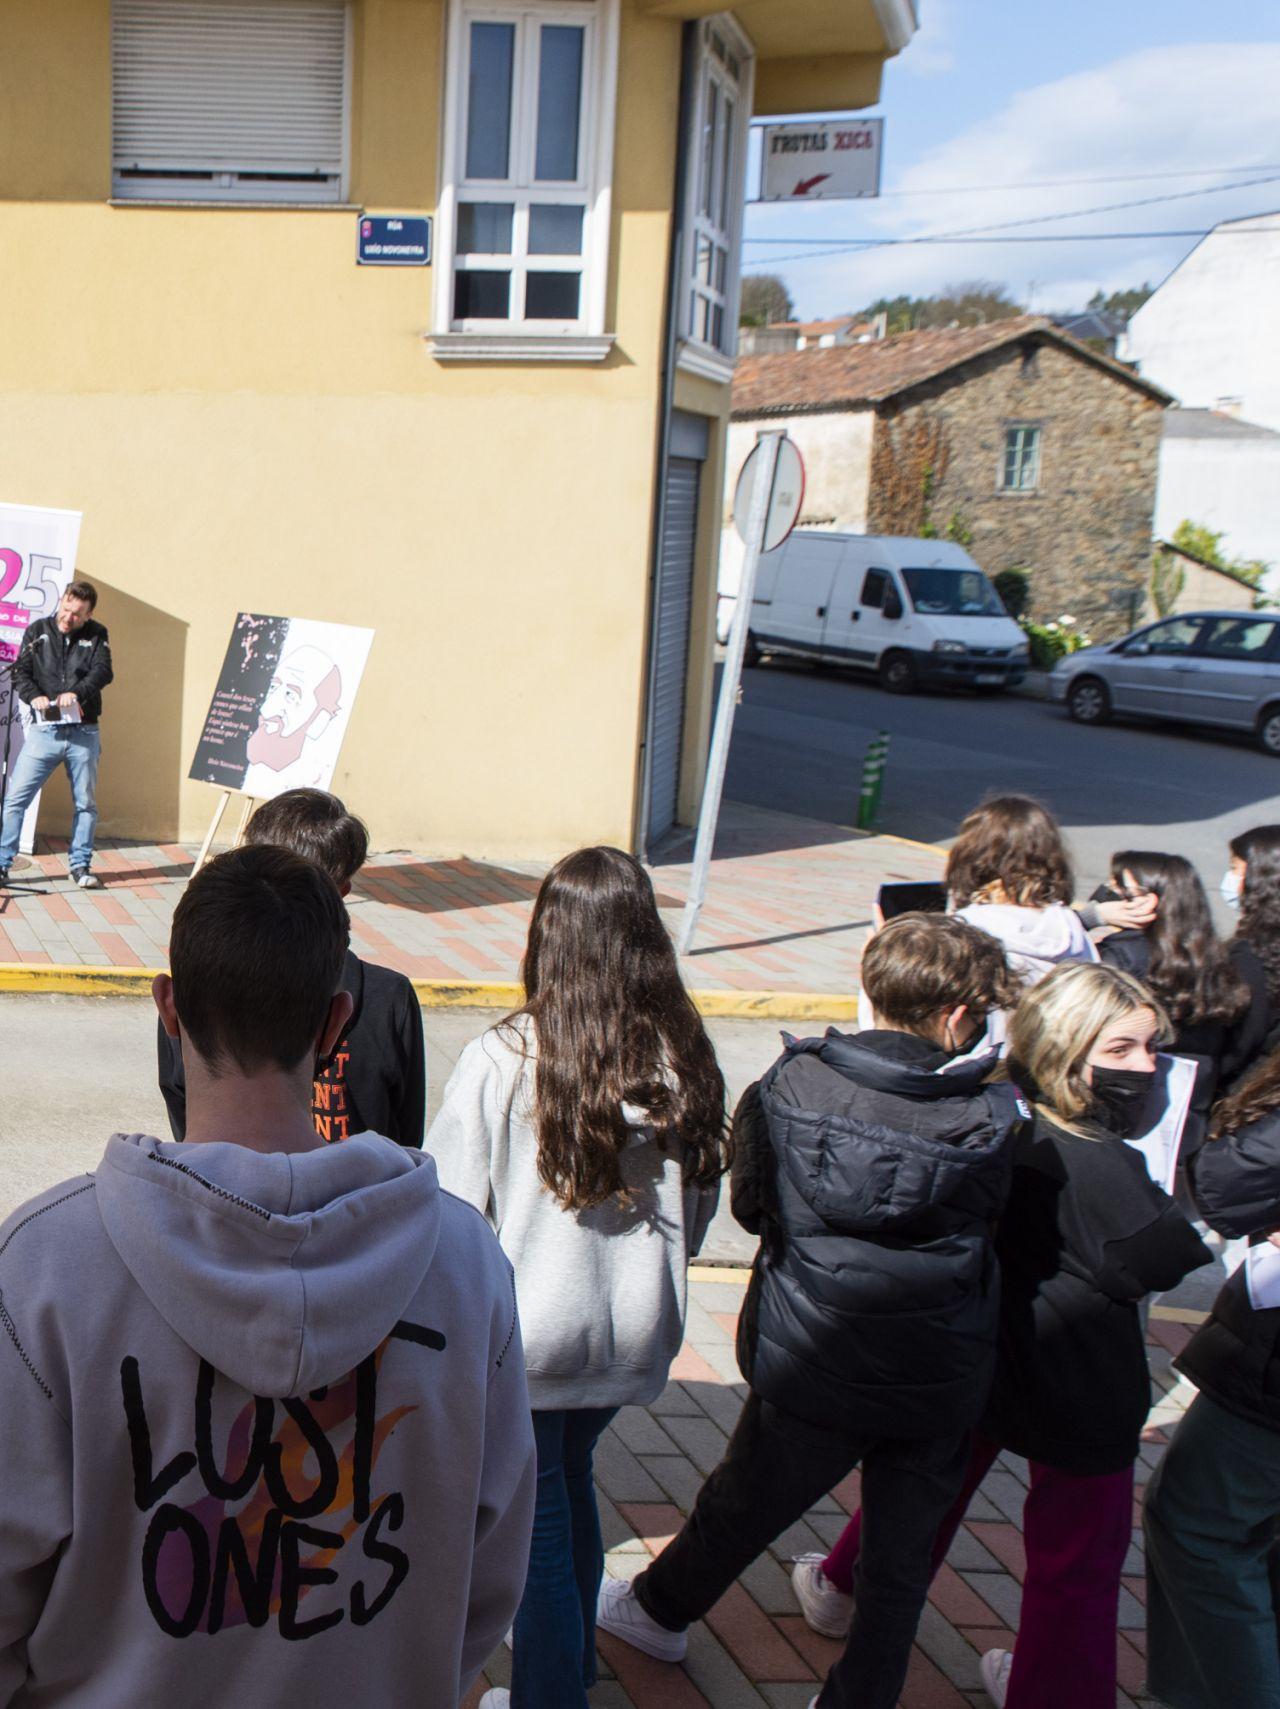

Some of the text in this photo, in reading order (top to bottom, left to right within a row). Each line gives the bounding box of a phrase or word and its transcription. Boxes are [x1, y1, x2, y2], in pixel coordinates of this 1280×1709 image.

[771, 129, 874, 155] FRUTAS XICA
[142, 1492, 410, 1641] ONES
